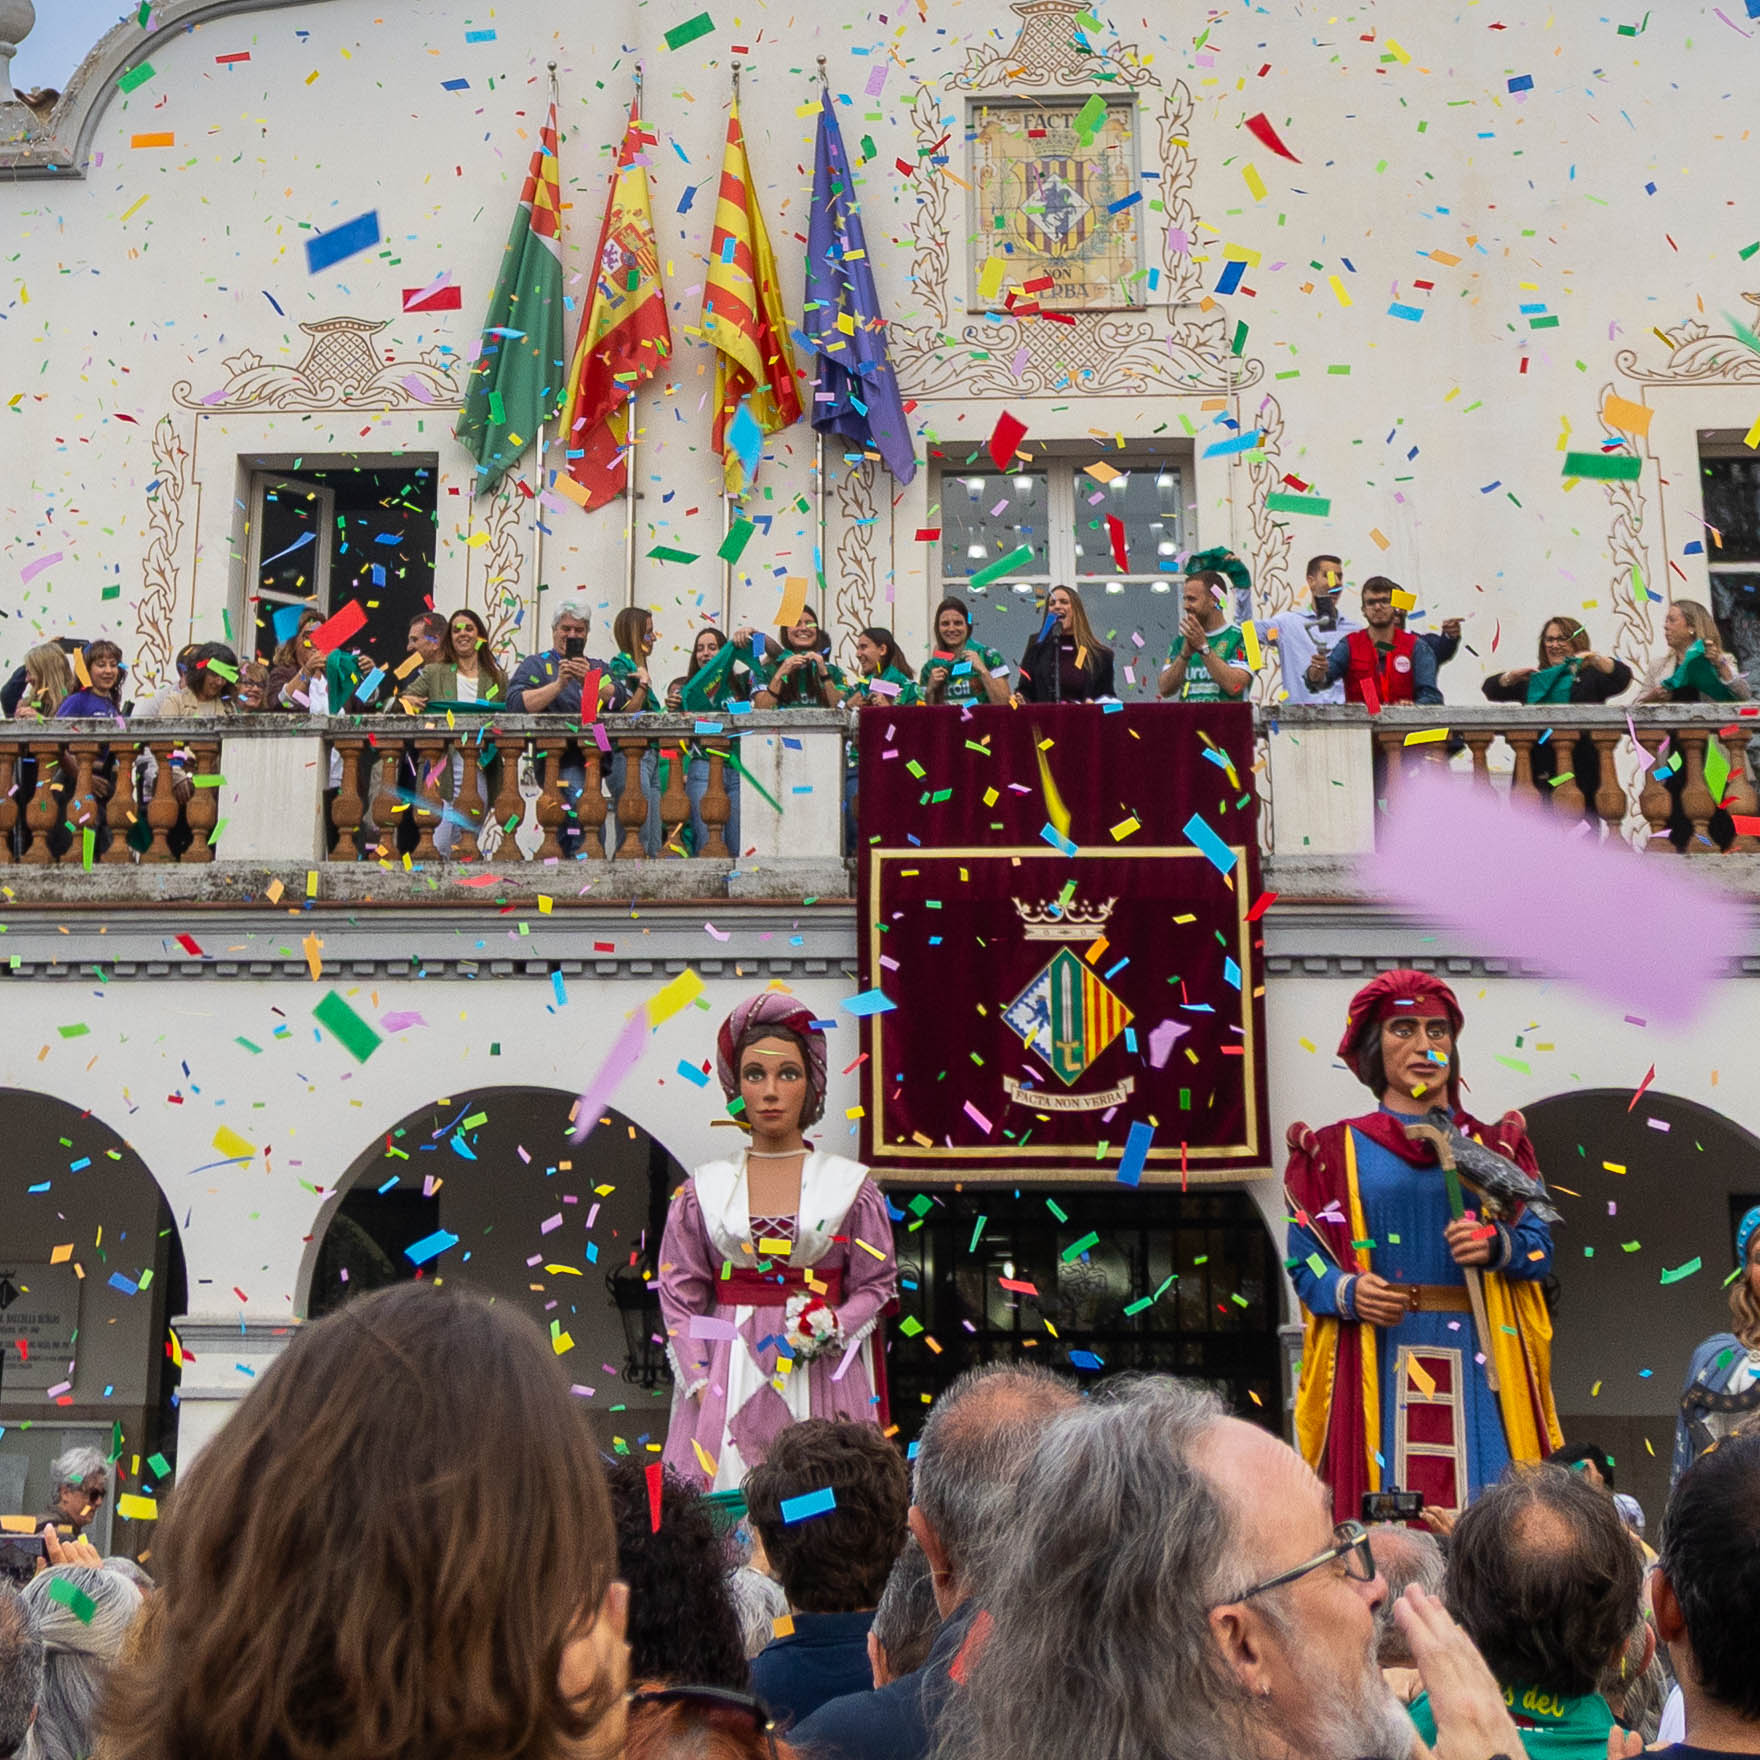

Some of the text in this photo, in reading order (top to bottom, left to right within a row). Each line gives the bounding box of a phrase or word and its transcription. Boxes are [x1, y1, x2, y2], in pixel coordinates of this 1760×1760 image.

[1023, 112, 1080, 129] FACT
[1043, 268, 1072, 280] NON
[1037, 283, 1089, 300] ERBA
[1015, 1090, 1123, 1108] FACTA NON VERBA
[1522, 1686, 1565, 1718] del
